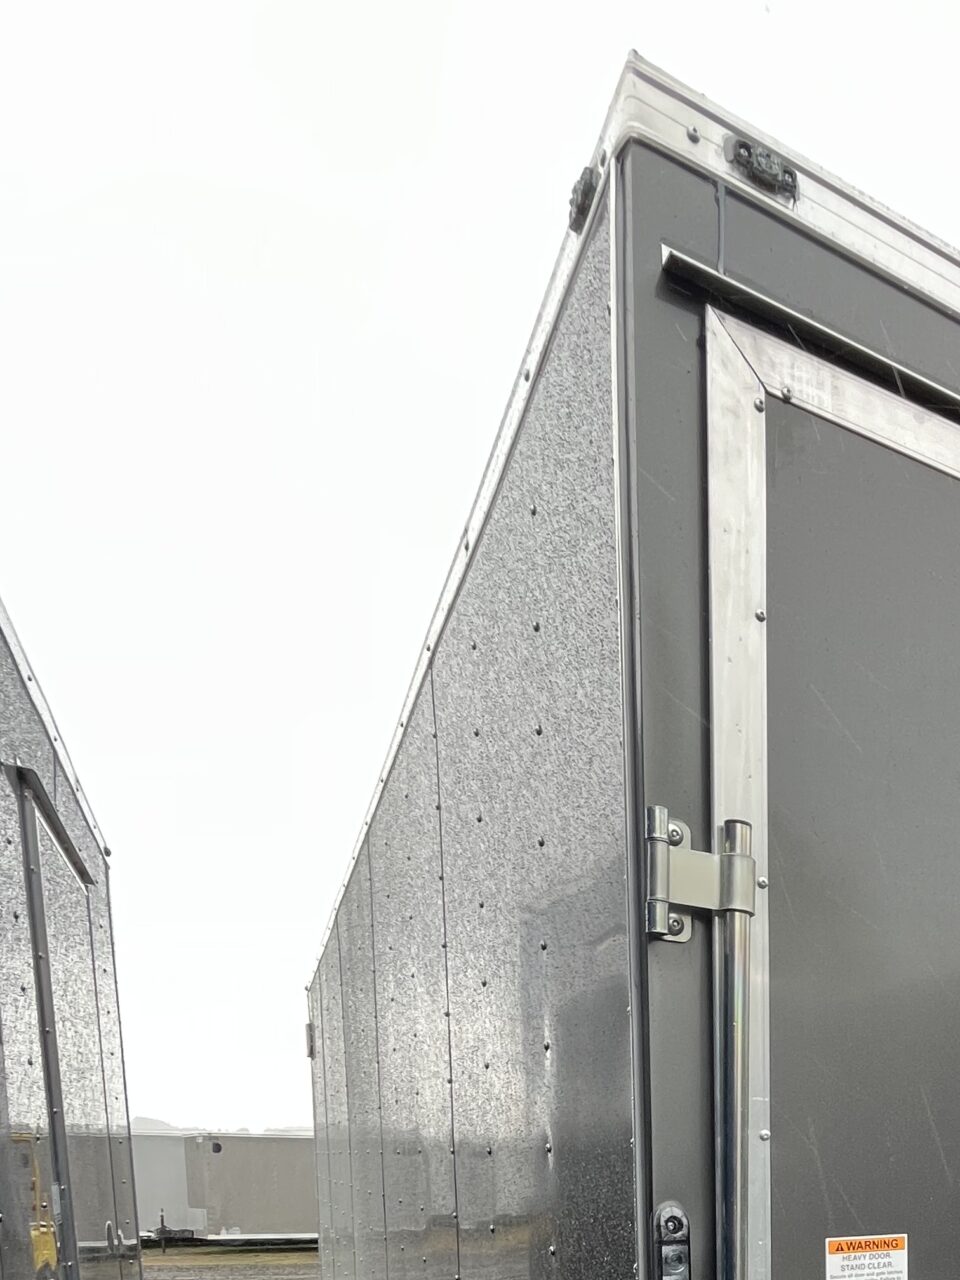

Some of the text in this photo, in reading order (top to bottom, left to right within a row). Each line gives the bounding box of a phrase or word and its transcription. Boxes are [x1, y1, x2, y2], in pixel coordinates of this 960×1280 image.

[846, 1239, 899, 1251] WARNING
[842, 1254, 867, 1262] HEAVY
[840, 1263, 866, 1272] STAND
